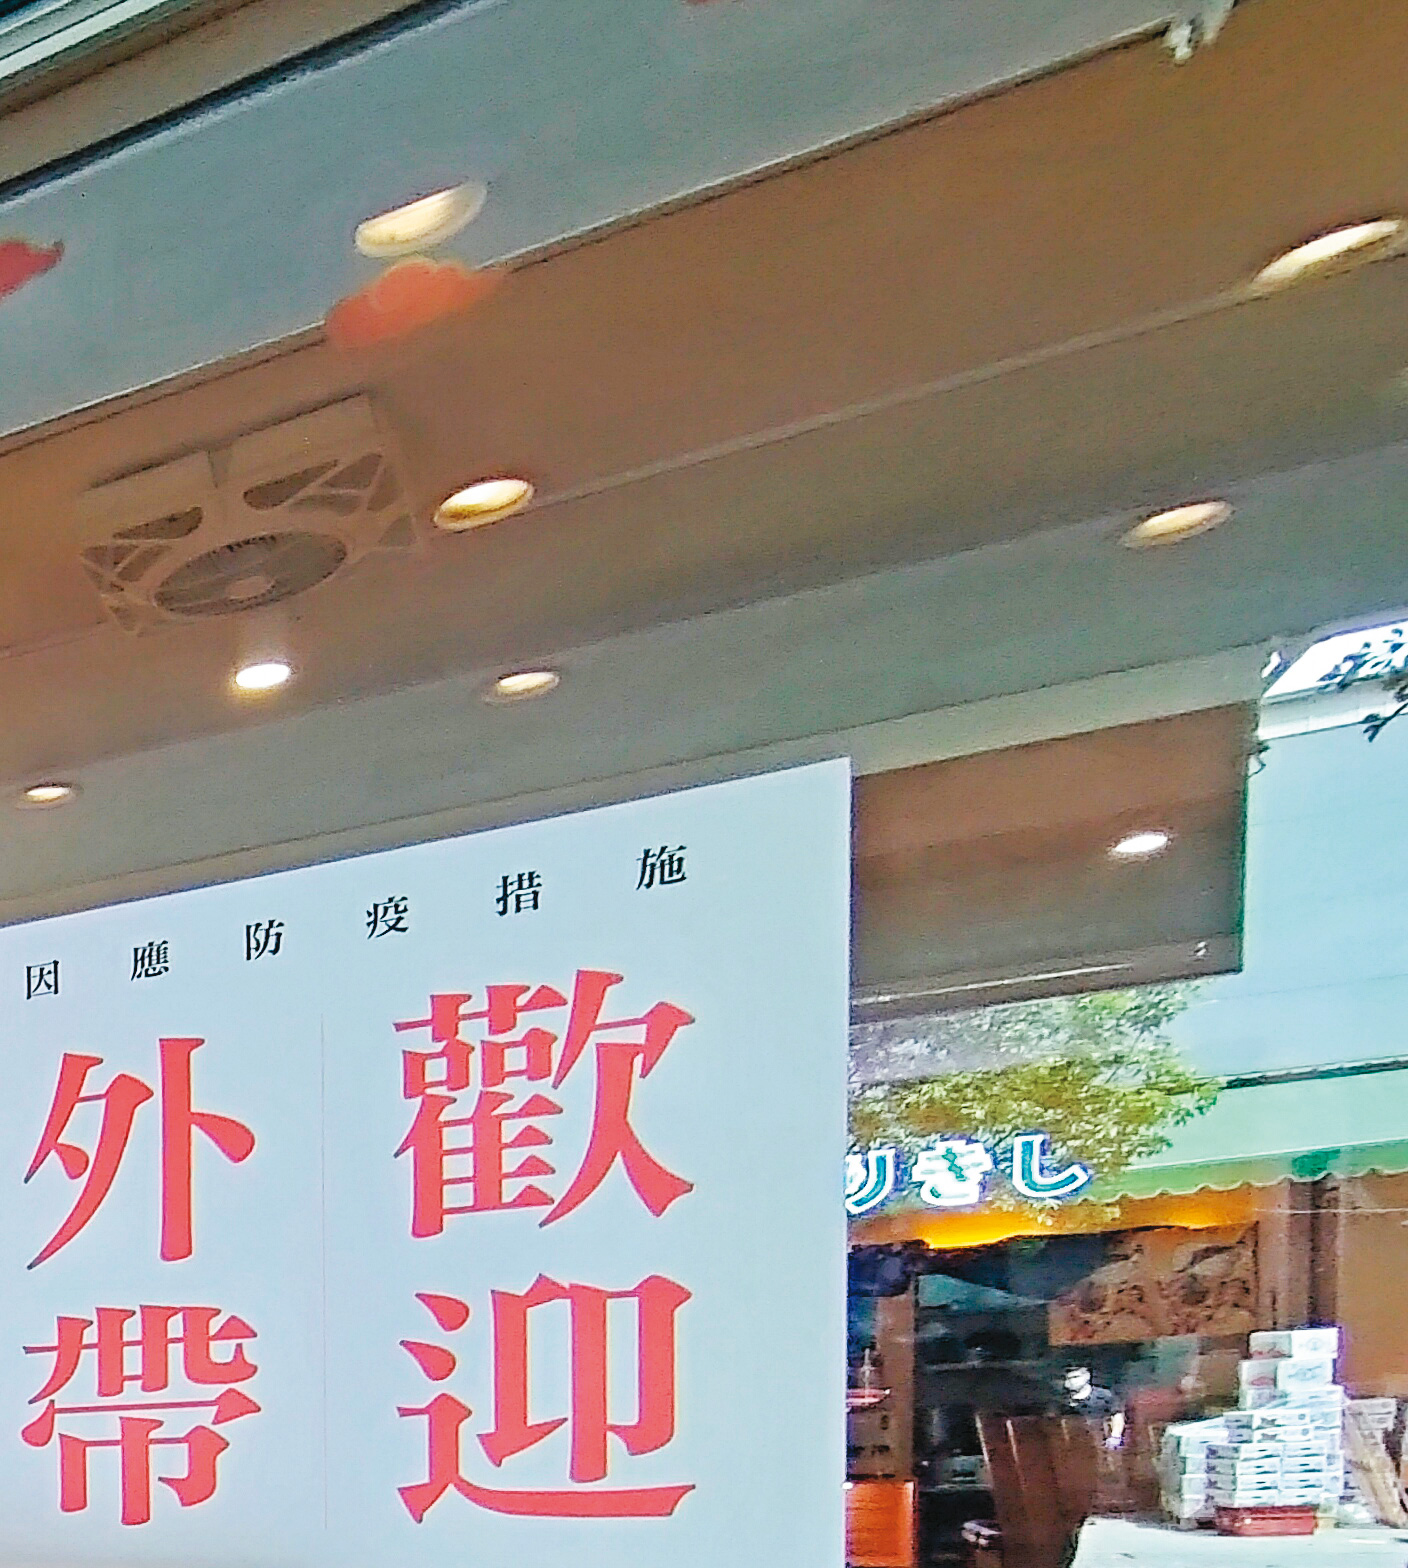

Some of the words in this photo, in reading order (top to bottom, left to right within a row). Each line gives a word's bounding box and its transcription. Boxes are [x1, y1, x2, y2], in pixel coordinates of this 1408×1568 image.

[25, 845, 687, 999] 因應防疫措施
[22, 1037, 261, 1525] 外帶
[393, 968, 697, 1523] 歡迎
